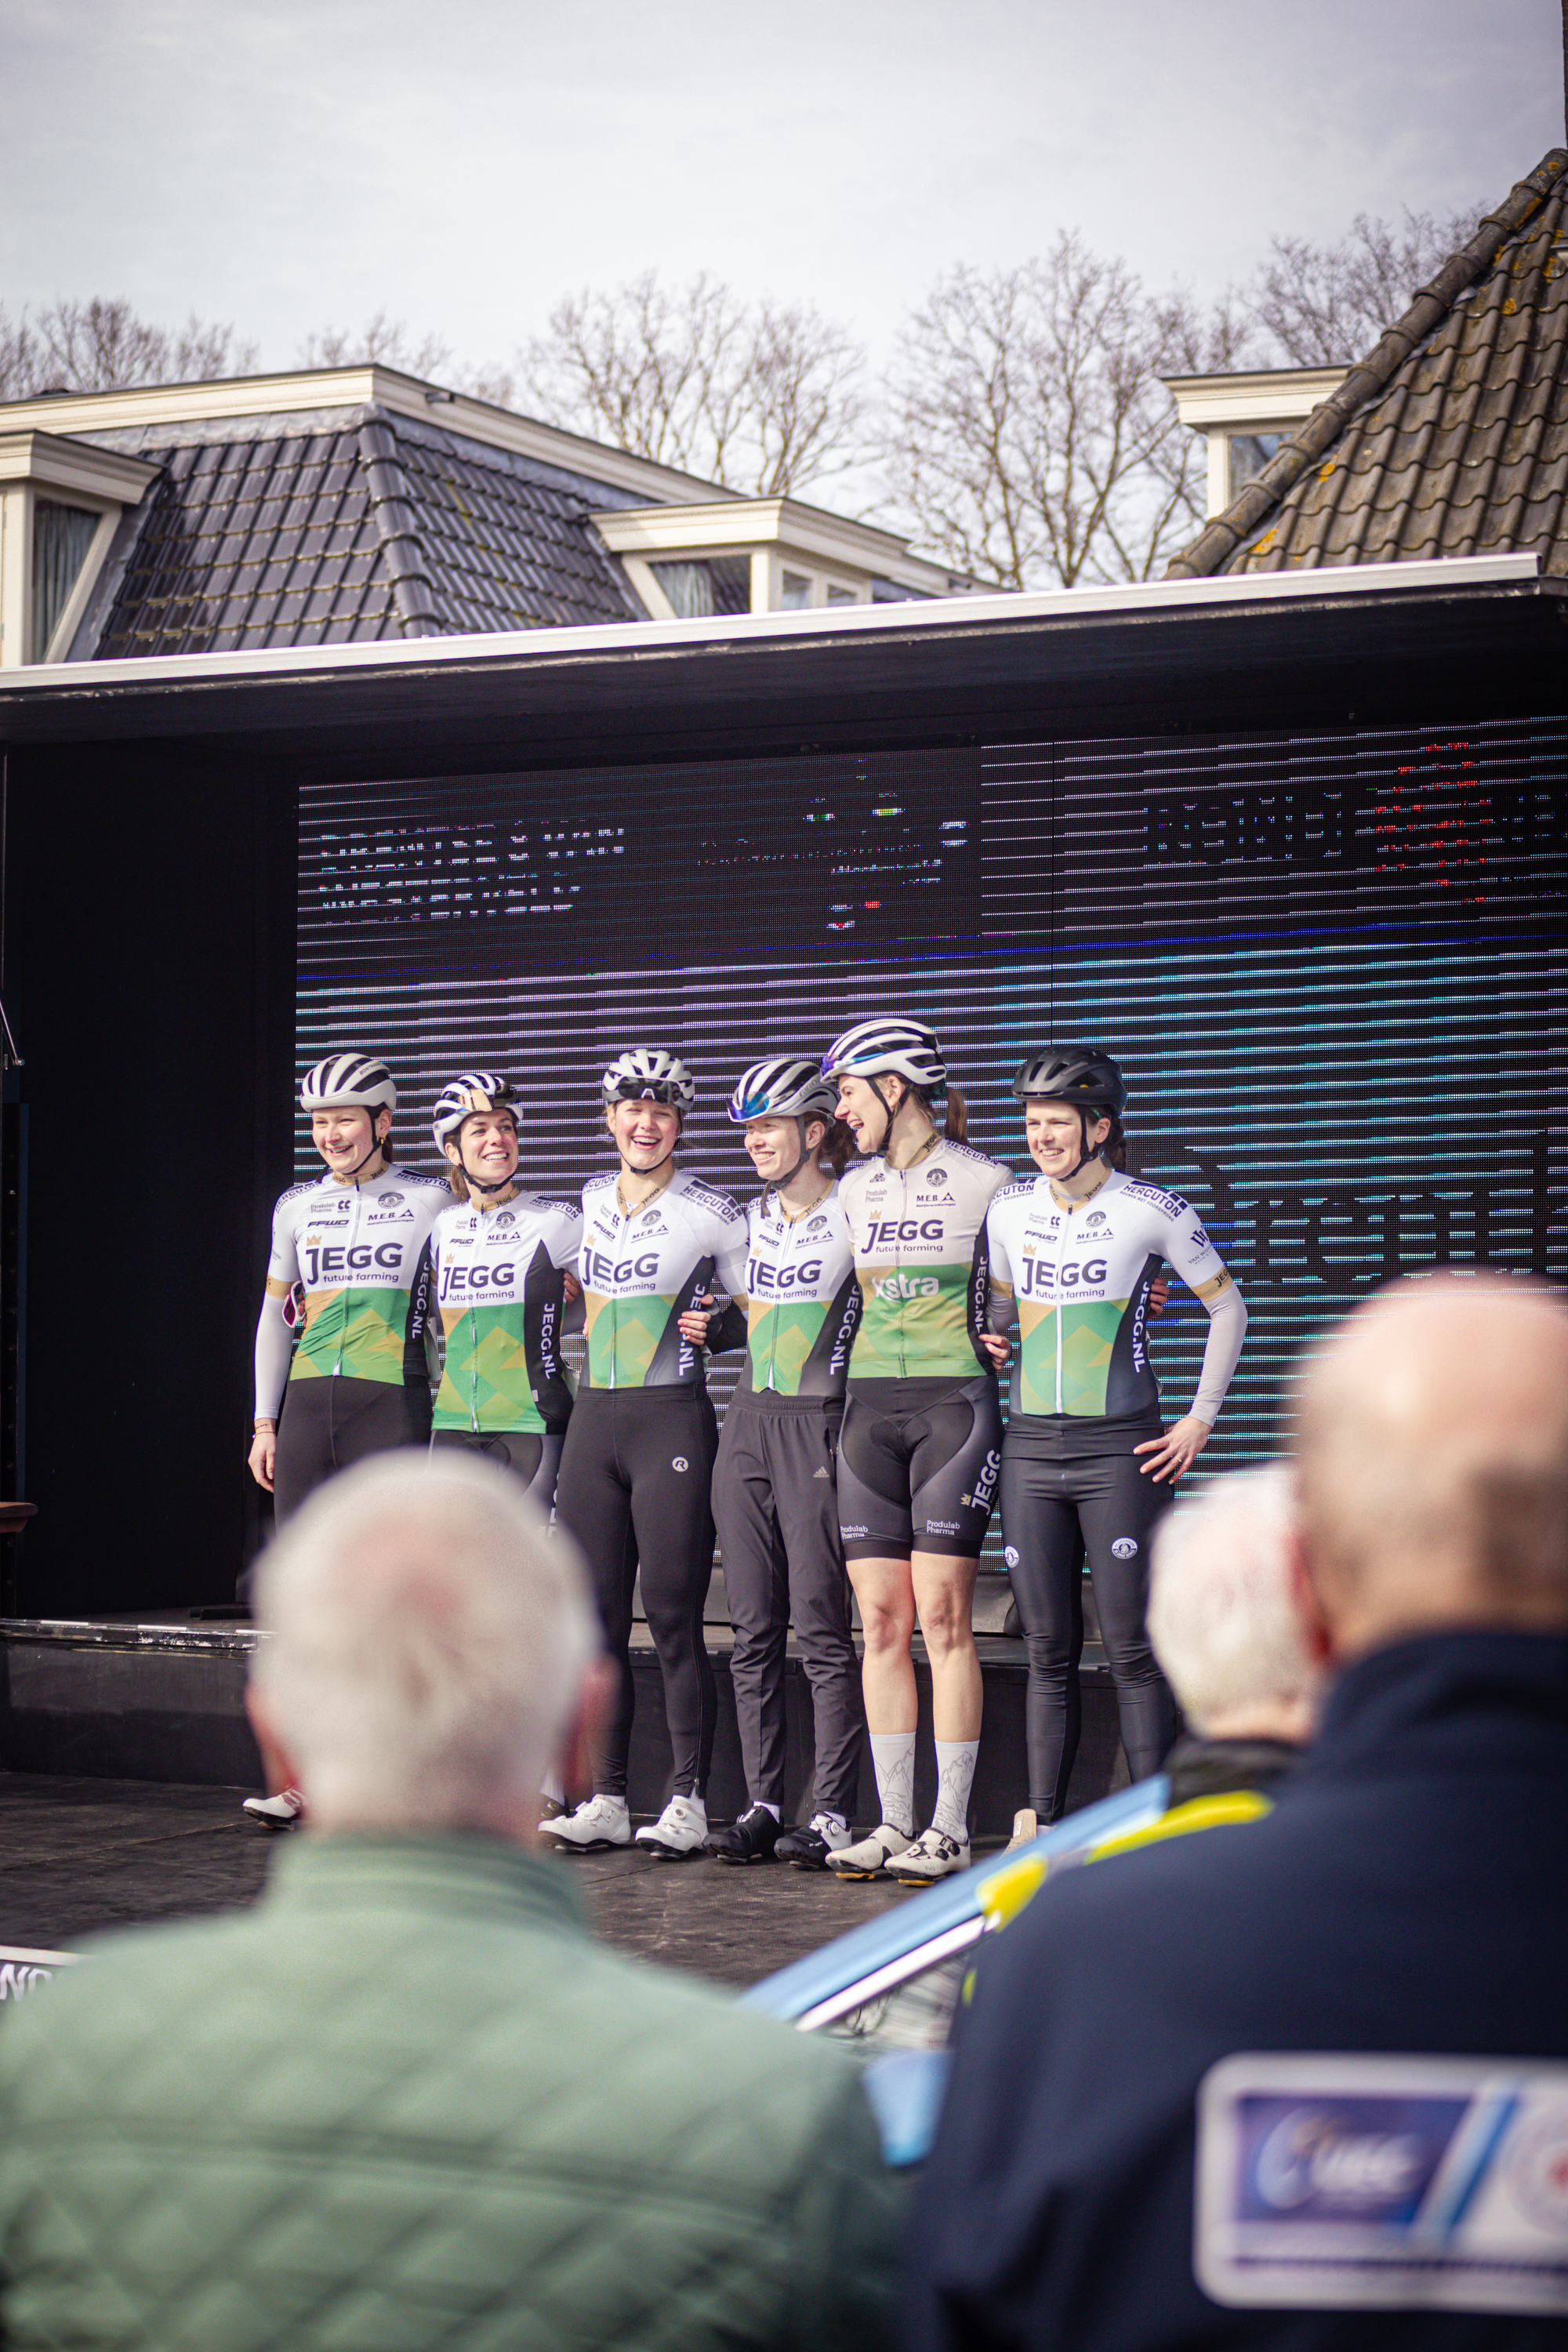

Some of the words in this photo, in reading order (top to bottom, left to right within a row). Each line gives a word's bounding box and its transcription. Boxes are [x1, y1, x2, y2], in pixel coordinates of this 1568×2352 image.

[923, 1134, 937, 1152] JEGG
[948, 1141, 998, 1165] HERCUTON
[397, 1172, 452, 1192] HERCUTON
[495, 1196, 511, 1208] JEGG
[532, 1198, 579, 1218] HERCUTON
[683, 1185, 738, 1222] HERCUTON
[1123, 1185, 1181, 1218] HERCUTON
[861, 1219, 944, 1254] JEGG
[306, 1243, 403, 1285] JEGG
[357, 1272, 398, 1283] farming
[582, 1247, 660, 1286] JEGG
[747, 1258, 823, 1294] JEGG
[1022, 1257, 1108, 1294] JEGG
[440, 1263, 515, 1301] JEGG
[476, 1290, 514, 1299] farming
[620, 1282, 655, 1294] farming
[783, 1288, 817, 1298] farming
[975, 1256, 989, 1334] JEGG.NL
[1066, 1288, 1105, 1298] farming
[412, 1261, 430, 1339] JEGG.NL
[541, 1303, 556, 1380] JEGG.NL
[678, 1283, 706, 1377] JE.NL
[829, 1285, 861, 1375] JEGG.NL
[1132, 1281, 1150, 1373] JEGG.NL
[971, 1450, 1001, 1516] JEGG
[926, 1526, 955, 1535] Pharma
[927, 1520, 960, 1529] Produlab
